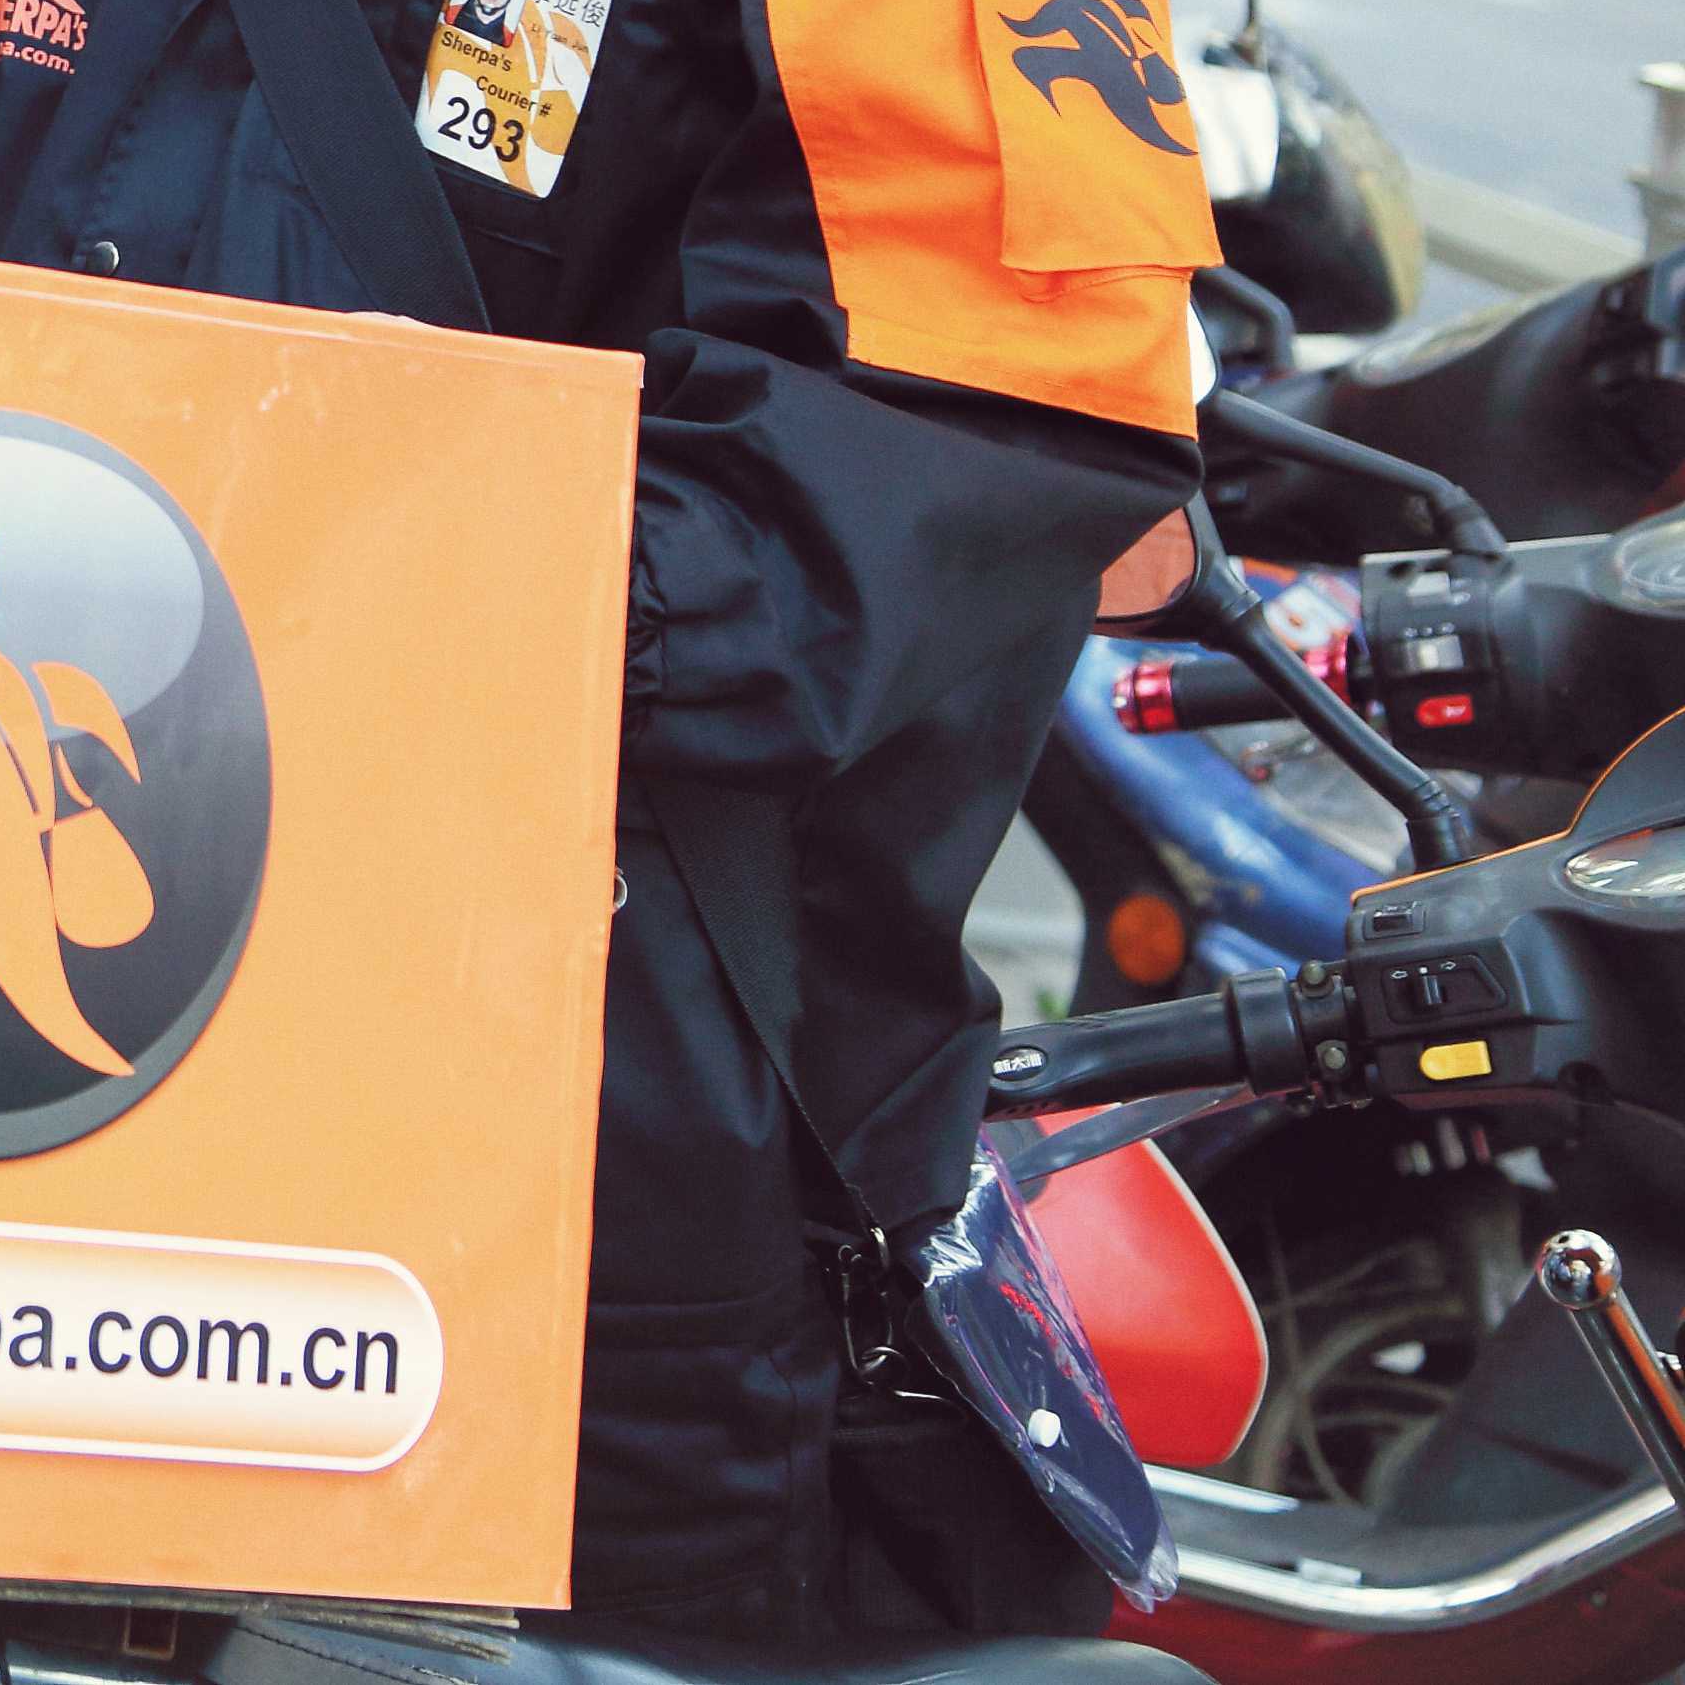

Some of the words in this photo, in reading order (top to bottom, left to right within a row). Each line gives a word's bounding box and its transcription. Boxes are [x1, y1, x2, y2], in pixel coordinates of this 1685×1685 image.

[441, 31, 512, 72] Sherpa's
[475, 75, 537, 113] Courier
[438, 96, 525, 162] 293
